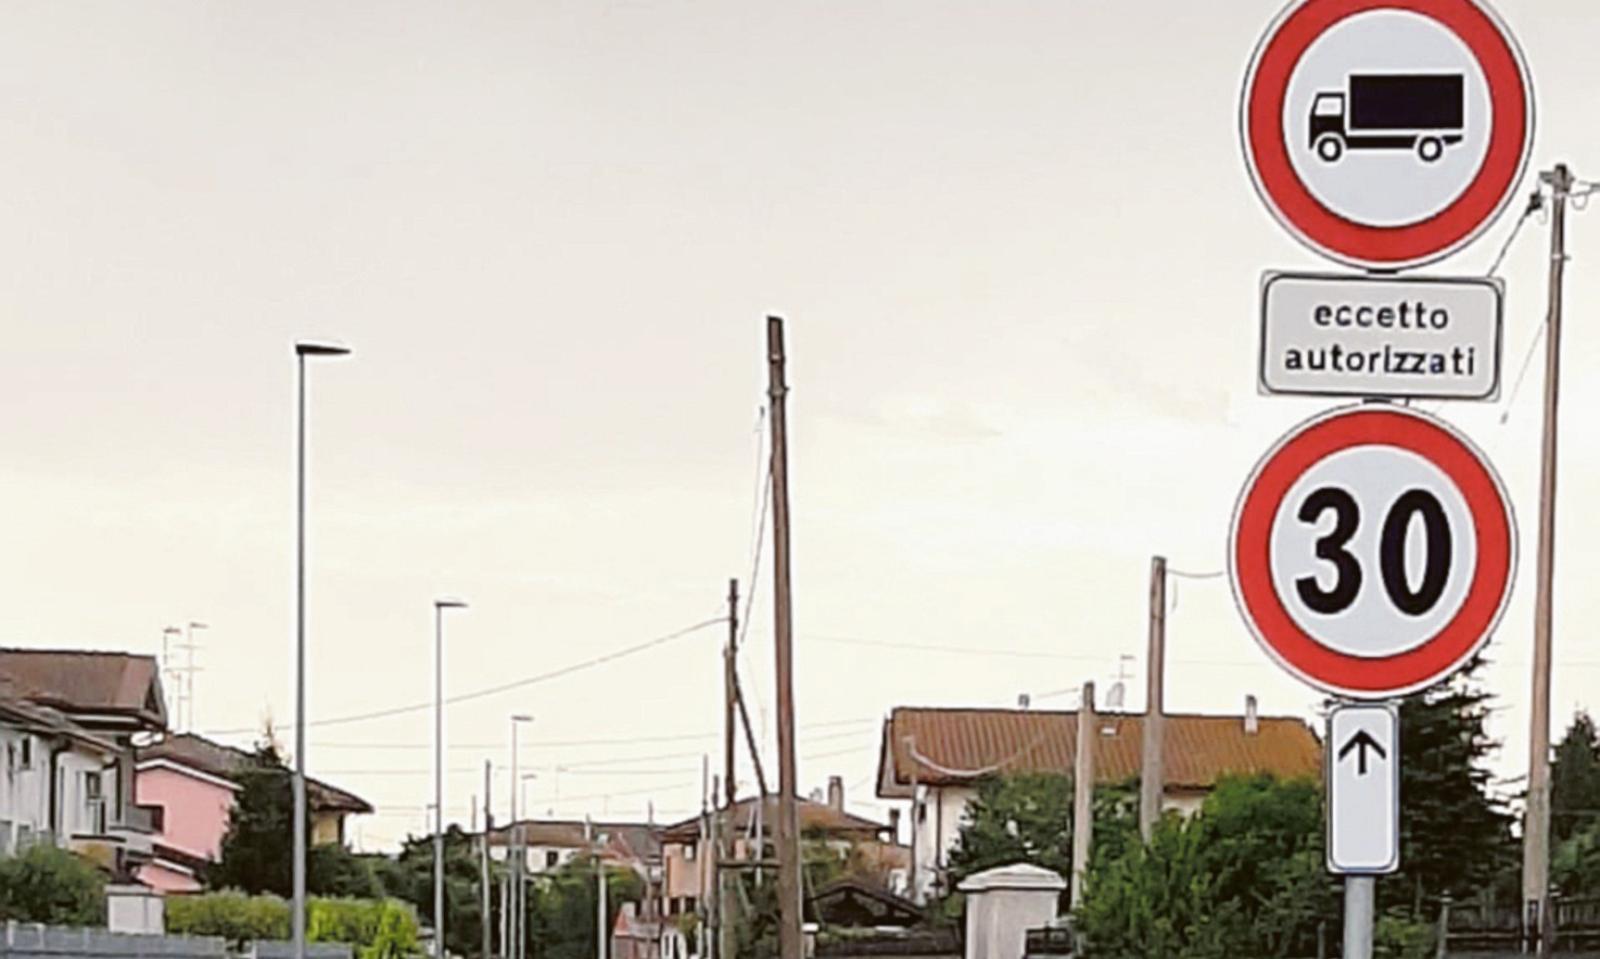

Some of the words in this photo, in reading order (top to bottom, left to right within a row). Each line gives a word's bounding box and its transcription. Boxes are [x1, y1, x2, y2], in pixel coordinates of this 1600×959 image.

[1314, 302, 1449, 329] eccetto
[1285, 345, 1475, 375] autorizzati
[1296, 487, 1452, 616] 30
